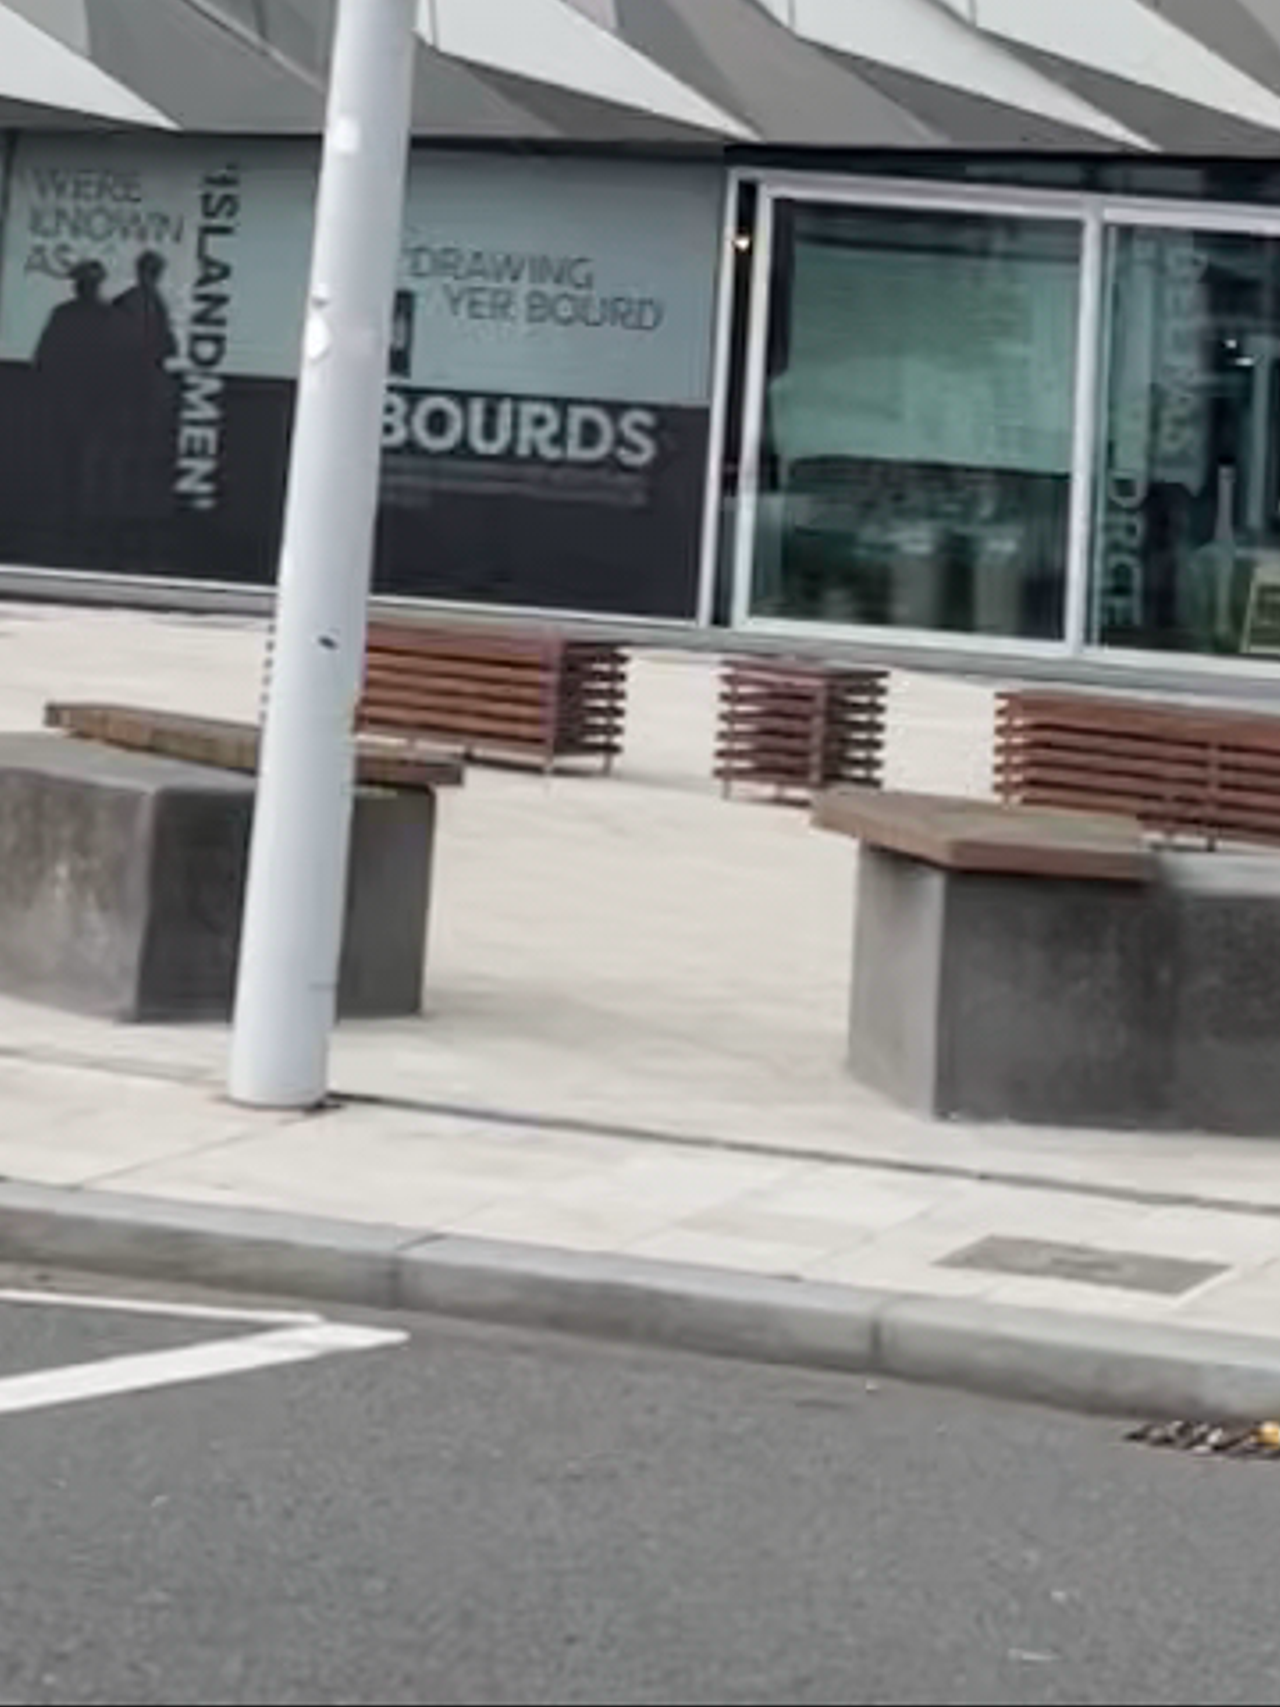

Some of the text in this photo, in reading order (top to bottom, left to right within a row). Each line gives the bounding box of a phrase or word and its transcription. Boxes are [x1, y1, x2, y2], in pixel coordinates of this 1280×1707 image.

[29, 168, 143, 203] WERE
[28, 206, 185, 243] KNOWN
[407, 246, 595, 290] DRAWING
[444, 283, 665, 331] YER BOURD
[381, 391, 657, 467] BOURDS
